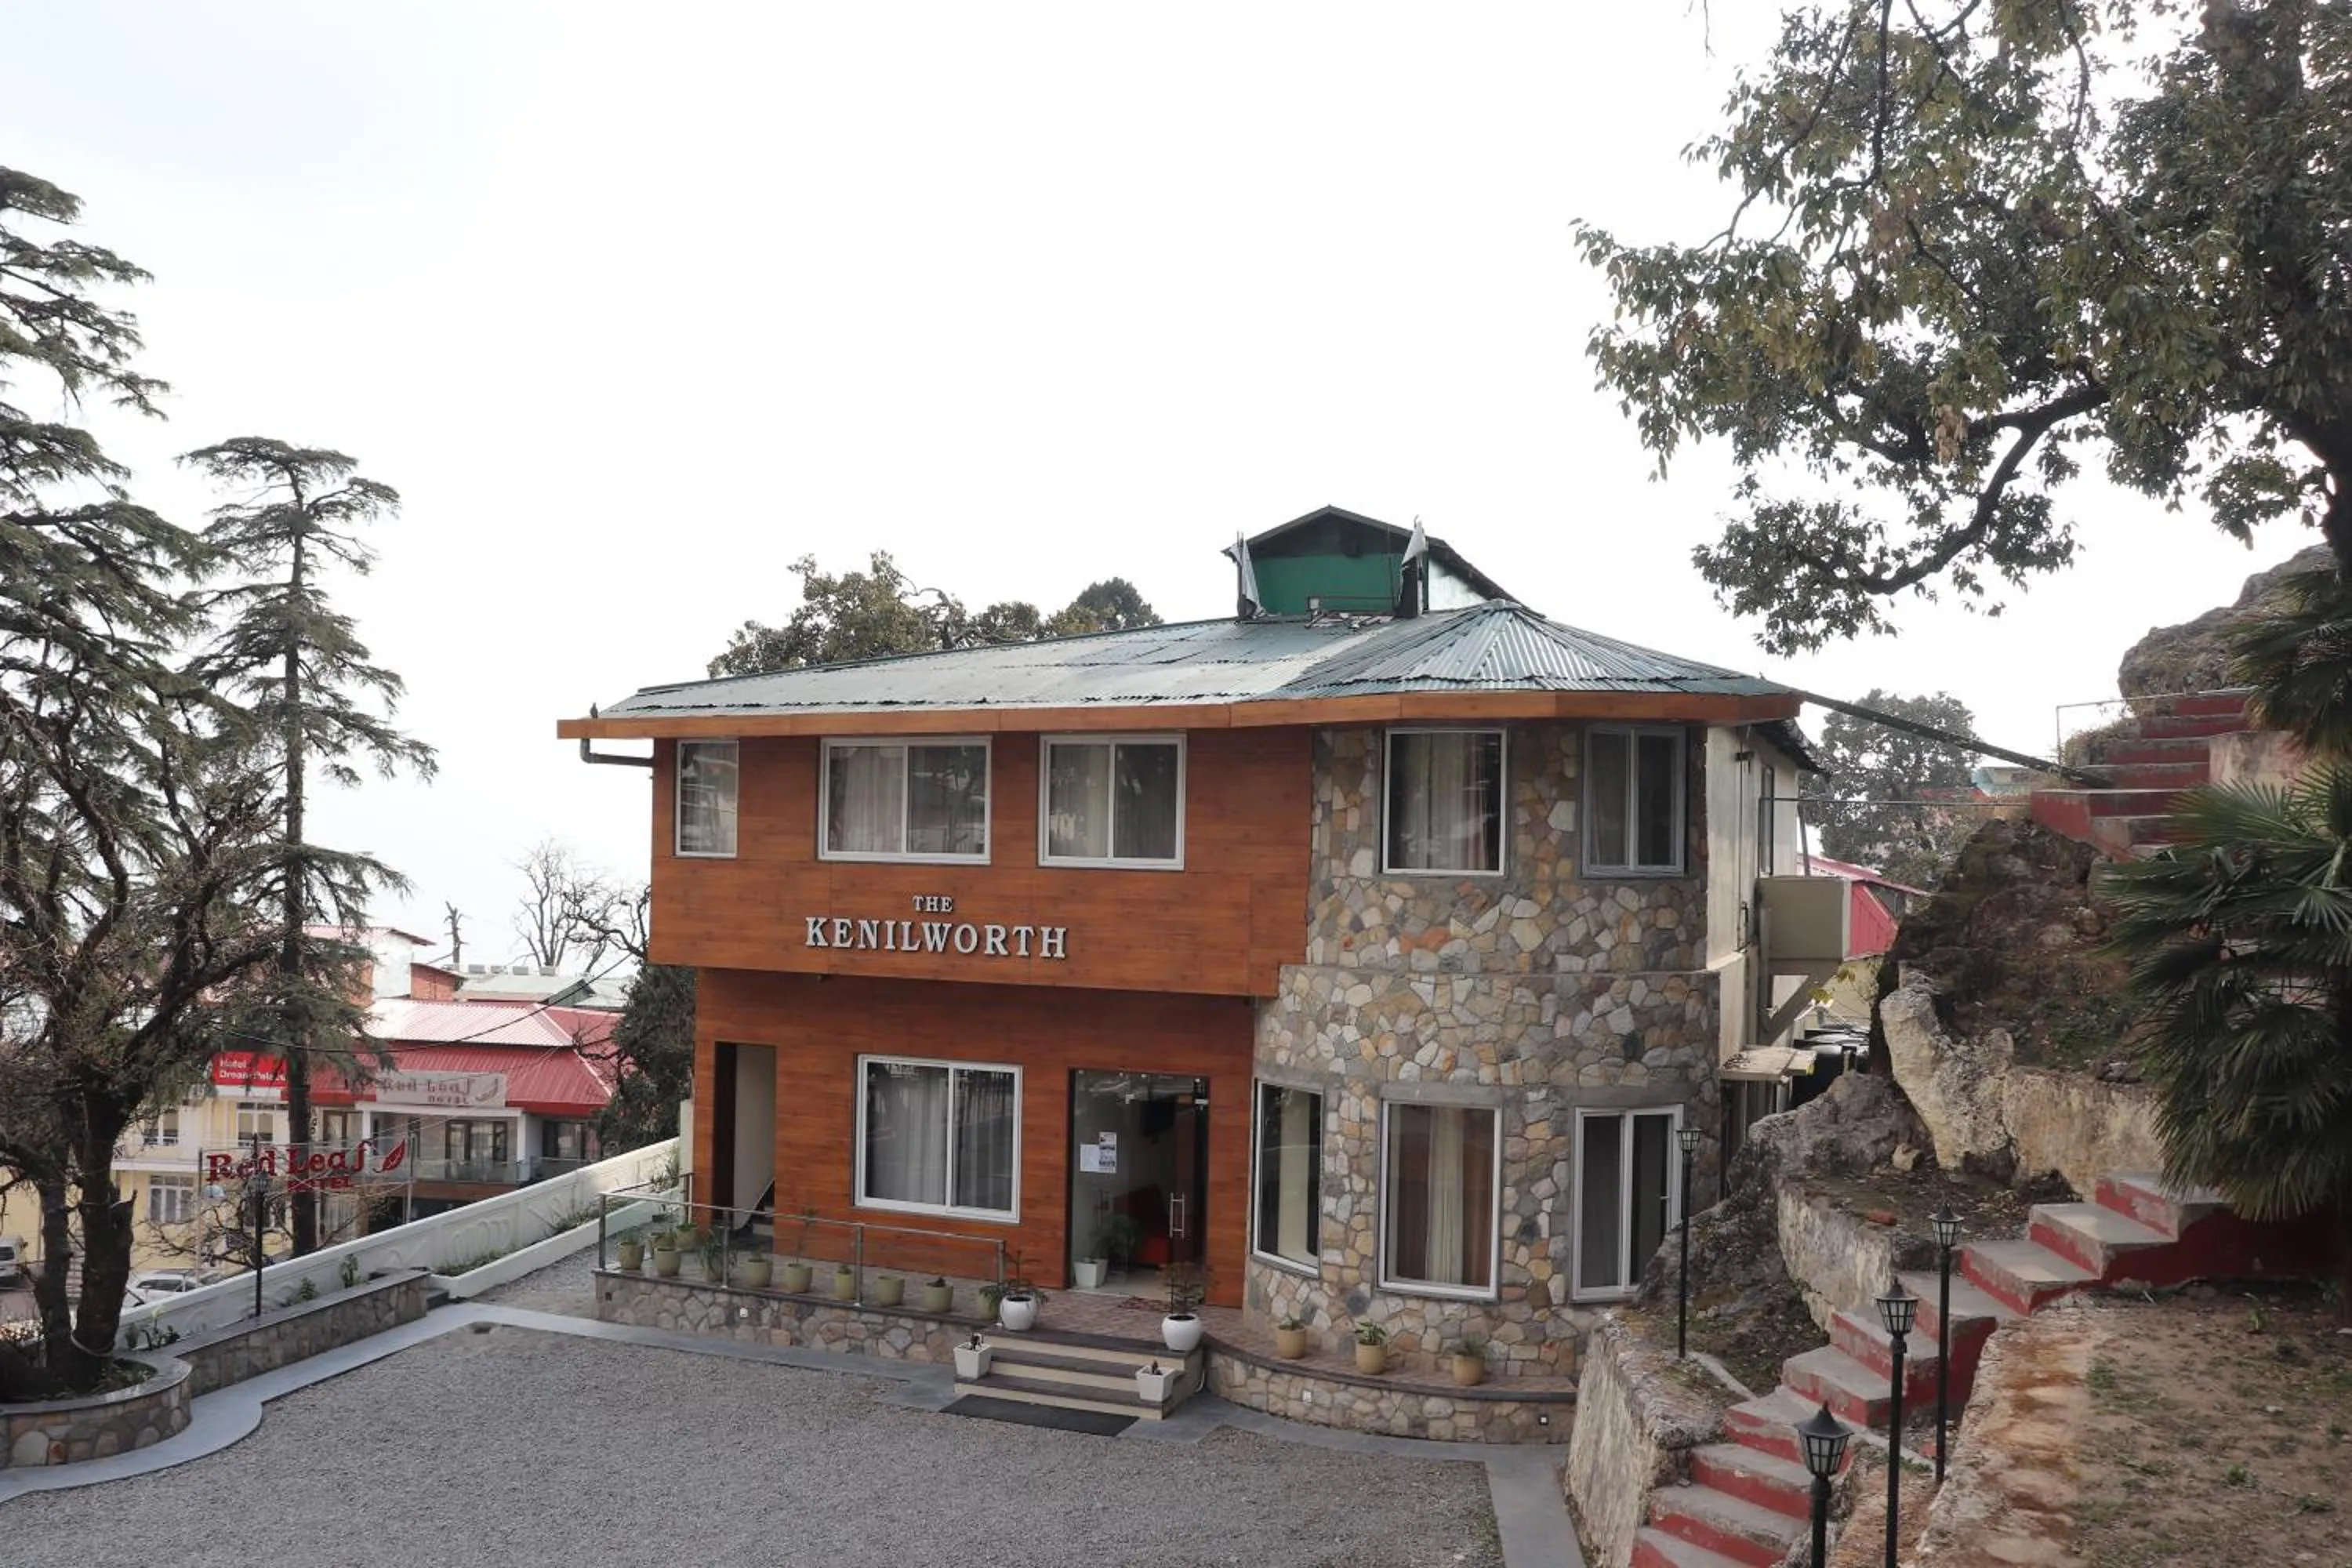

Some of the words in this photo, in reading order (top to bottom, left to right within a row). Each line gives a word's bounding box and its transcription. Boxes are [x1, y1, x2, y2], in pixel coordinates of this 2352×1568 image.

[913, 895, 953, 913] THE
[805, 916, 1067, 958] KENILWORTH
[220, 1058, 248, 1069] Hotel
[426, 1077, 476, 1096] Leaf
[205, 1147, 278, 1182] Red
[285, 1139, 372, 1174] Leaf
